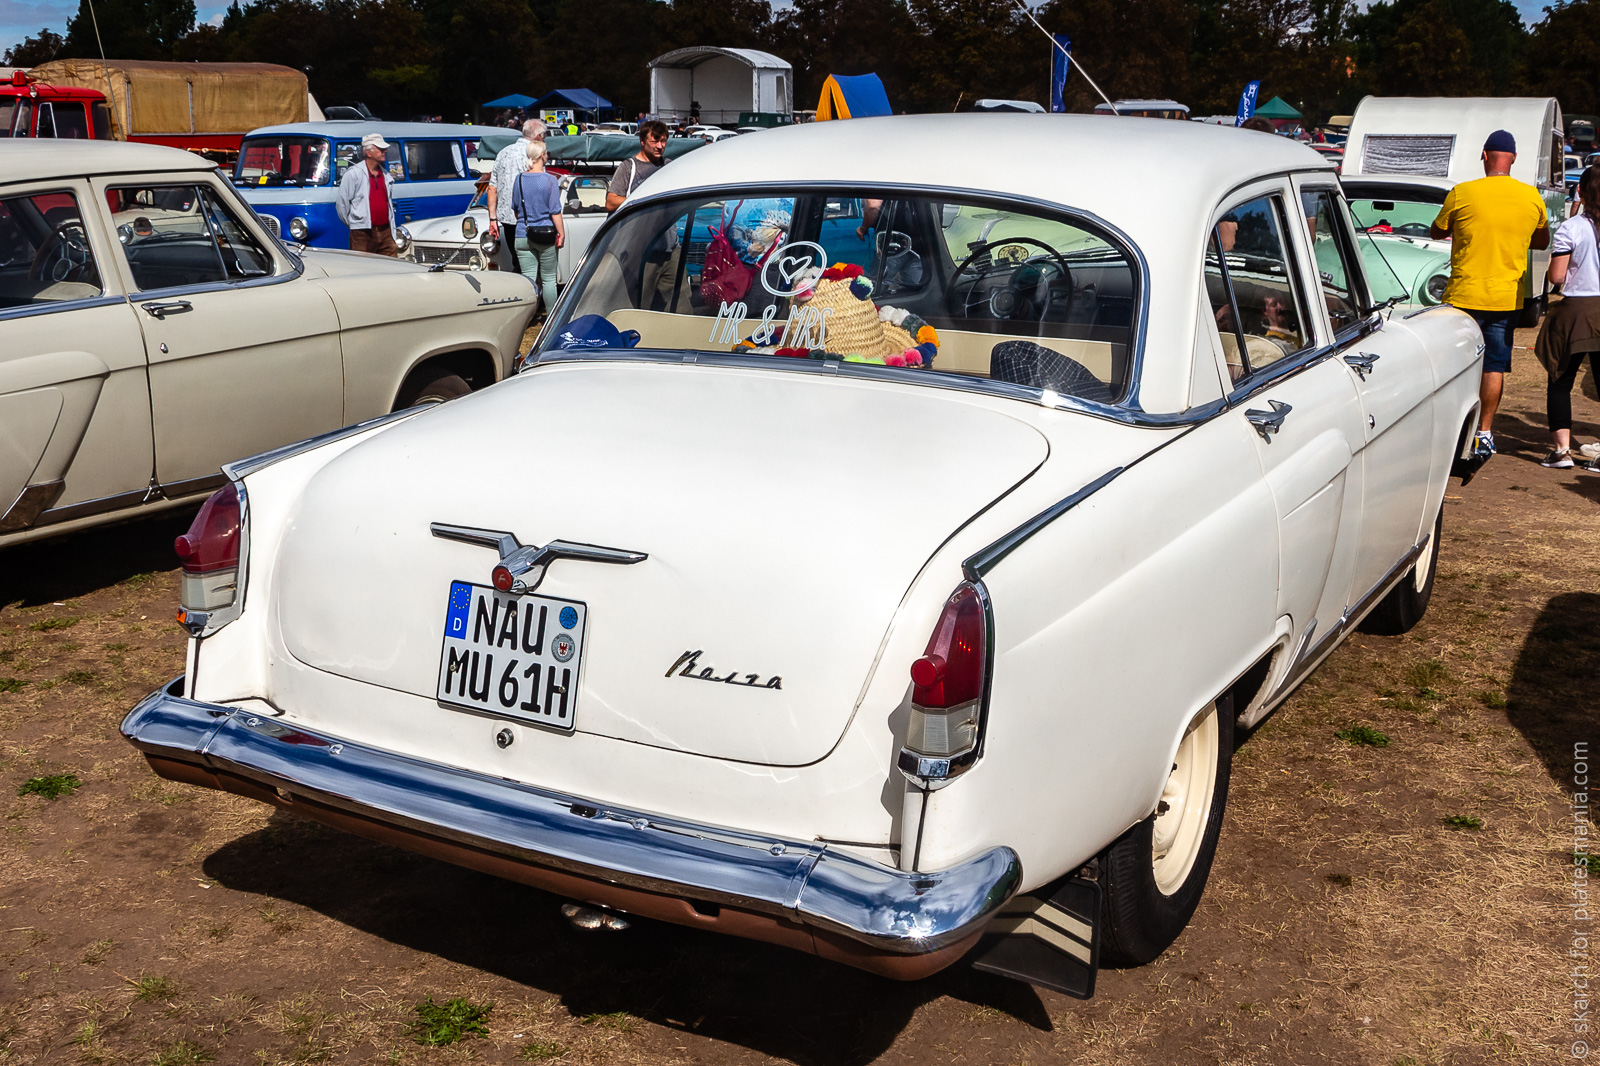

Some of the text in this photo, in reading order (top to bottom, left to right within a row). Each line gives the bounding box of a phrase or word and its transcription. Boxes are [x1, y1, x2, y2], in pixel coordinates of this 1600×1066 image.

[709, 301, 833, 350] MR. & MRS.
[453, 617, 462, 631] D
[473, 595, 548, 656] NAU
[445, 646, 493, 703] MU
[499, 659, 571, 718] 61H
